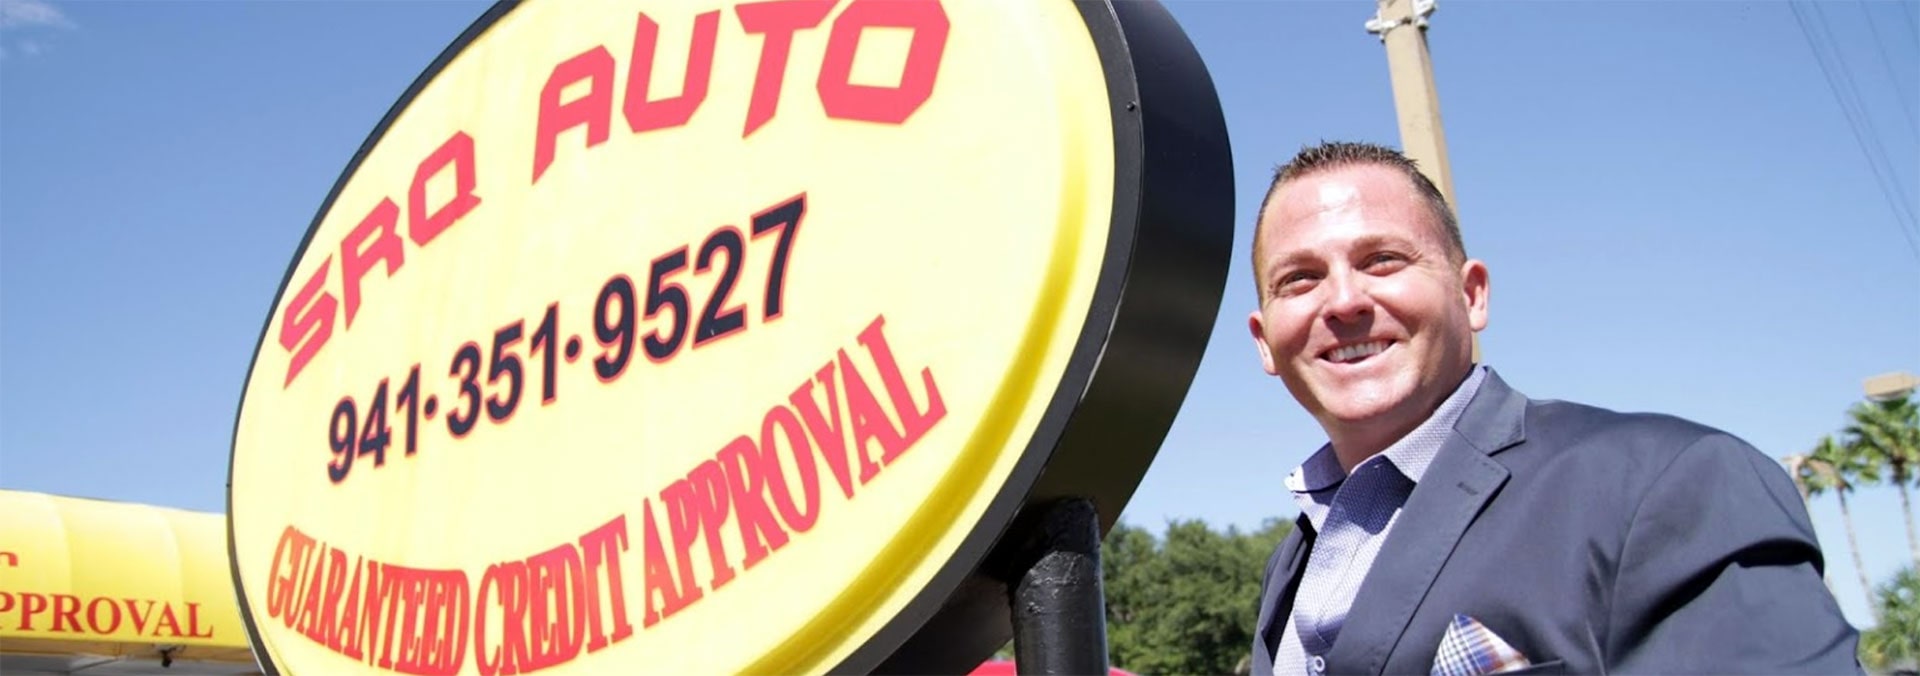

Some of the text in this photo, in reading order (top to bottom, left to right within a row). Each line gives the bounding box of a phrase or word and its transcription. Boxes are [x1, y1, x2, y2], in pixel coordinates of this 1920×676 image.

[278, 0, 951, 390] SRQ AUTO
[266, 313, 948, 676] GUARANTEED CREDIT APPROVAL
